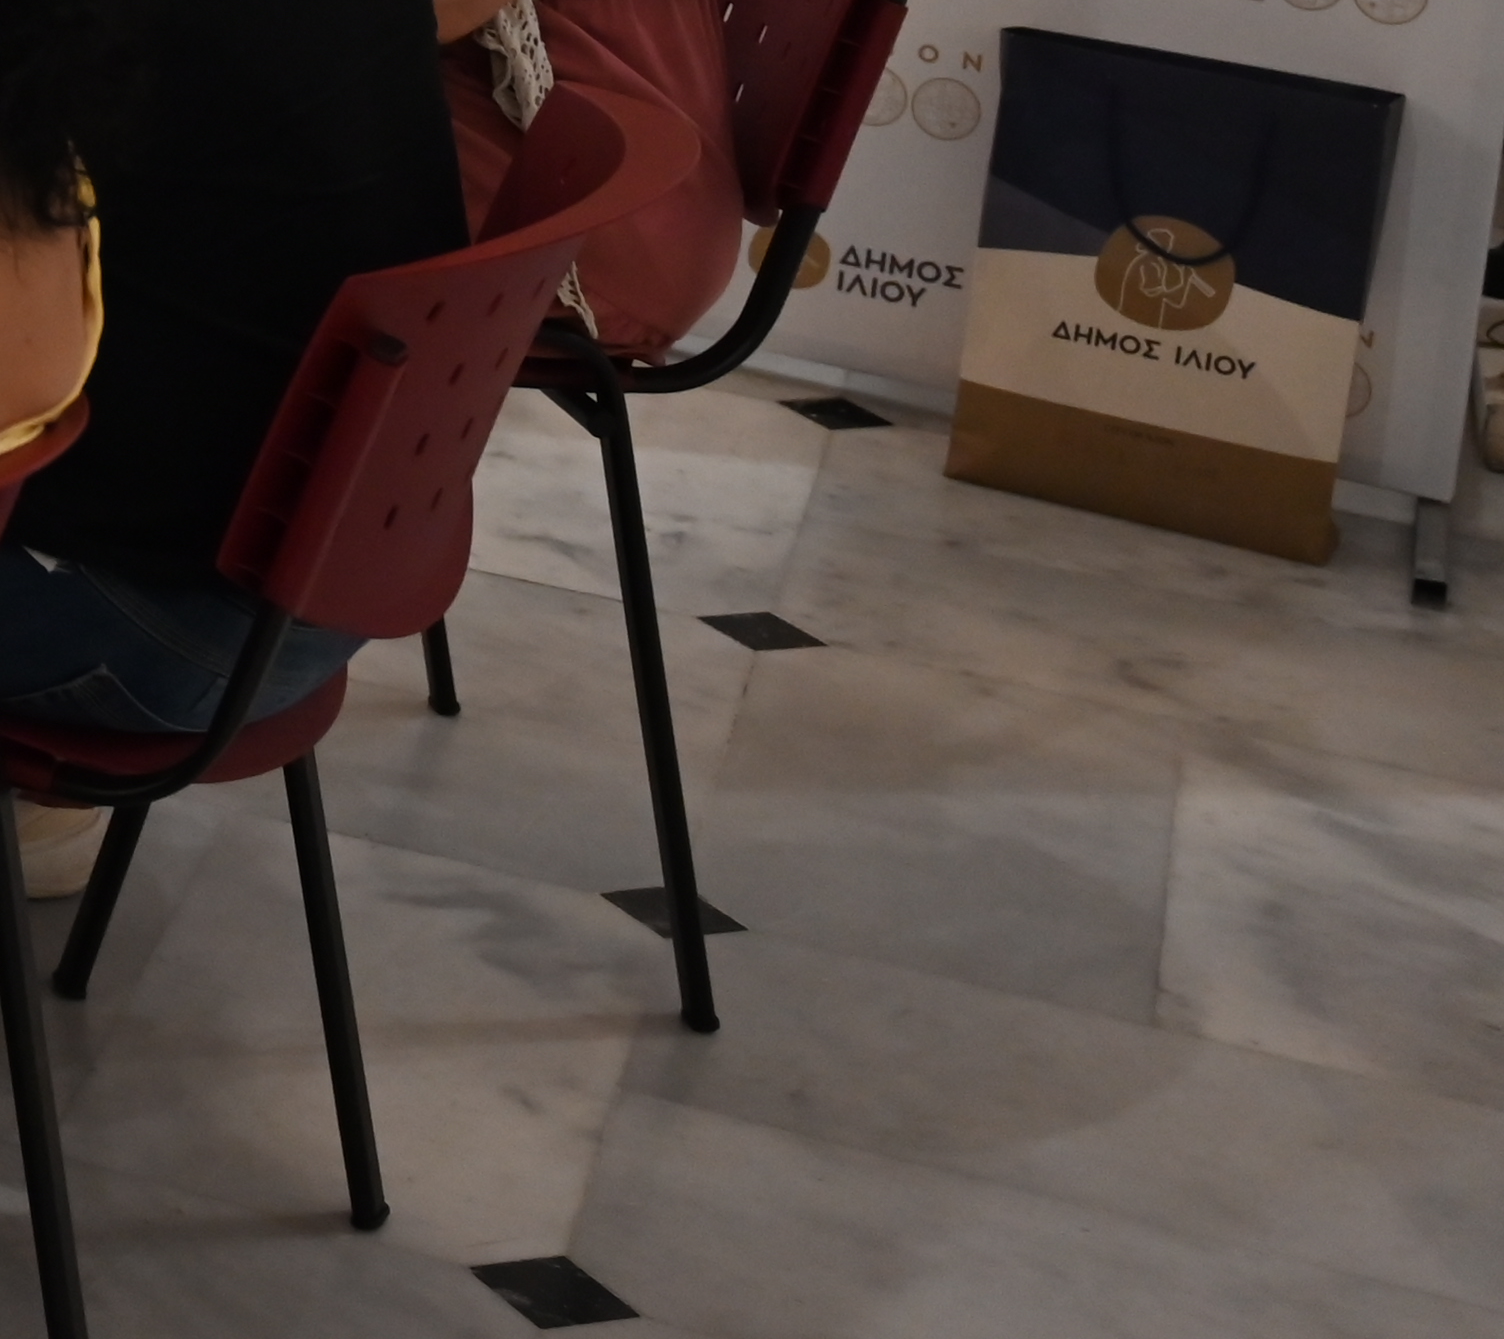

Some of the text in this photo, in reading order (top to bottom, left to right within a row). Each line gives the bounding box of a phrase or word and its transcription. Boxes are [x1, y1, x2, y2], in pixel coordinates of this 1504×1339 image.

[837, 245, 964, 290] ΔΗΜΟΣ
[837, 268, 928, 307] ΙΛΙΟΥ
[1052, 319, 1256, 380] ΔΗΜΟΣ ΙΛΙΟΥ
